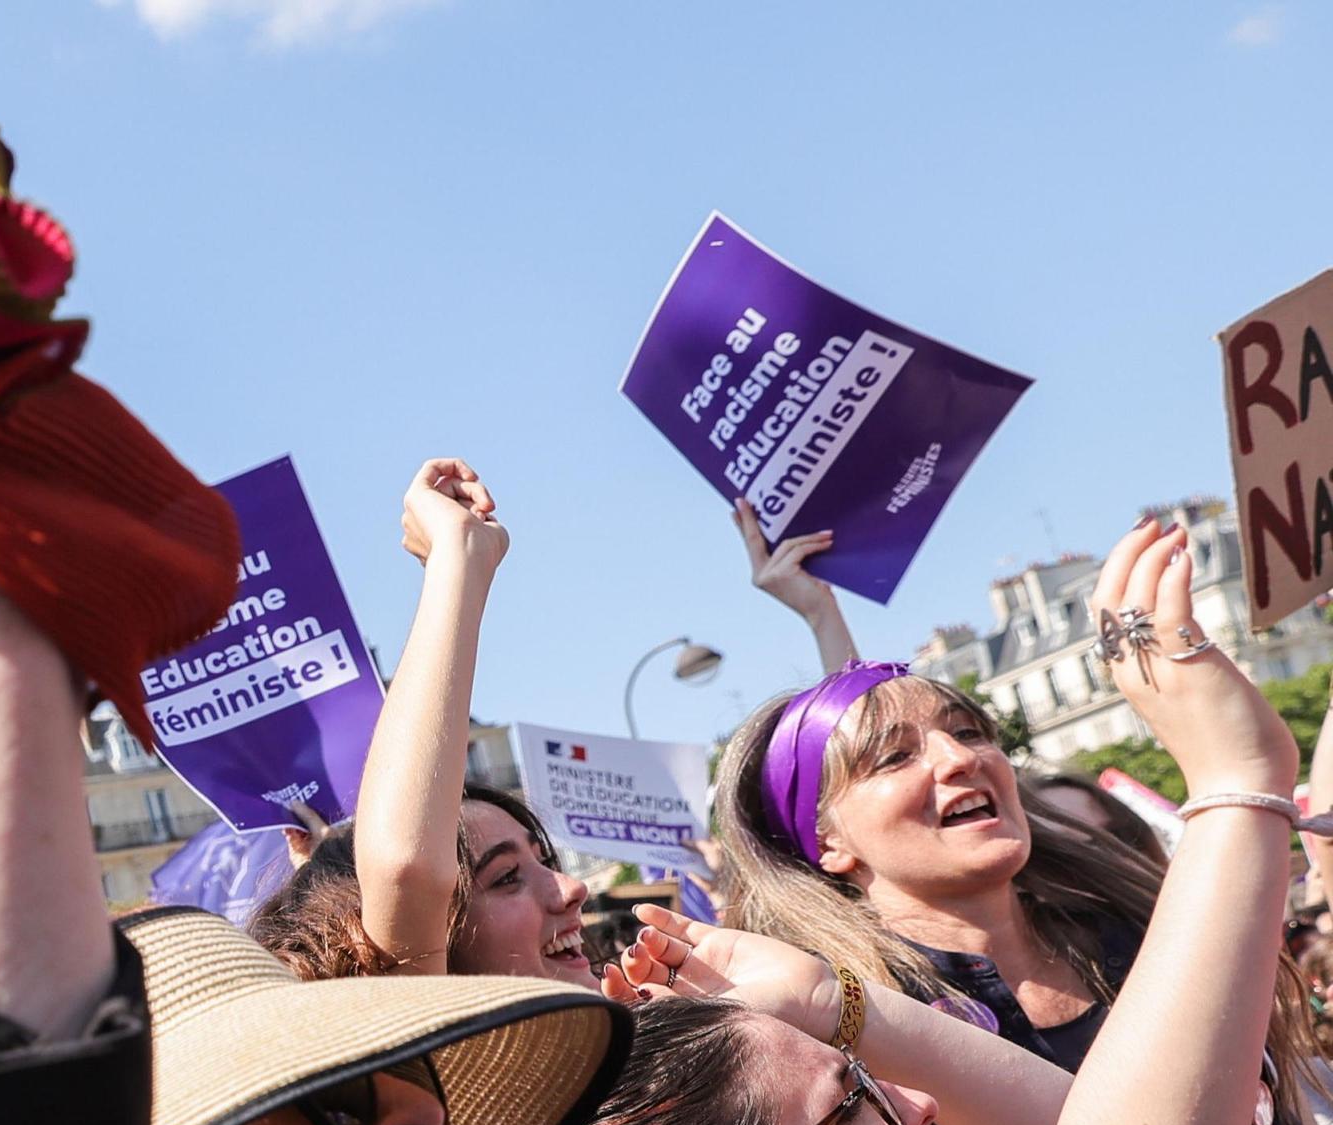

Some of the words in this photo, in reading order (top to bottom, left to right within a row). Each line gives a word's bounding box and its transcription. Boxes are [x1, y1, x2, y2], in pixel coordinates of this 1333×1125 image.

[680, 353, 733, 424] Face
[726, 307, 767, 354] au
[708, 331, 802, 451] racisme
[723, 334, 854, 491] Education
[751, 364, 882, 530] féministe
[139, 616, 323, 697] Education
[152, 660, 324, 736] féministe
[630, 825, 680, 845] NON
